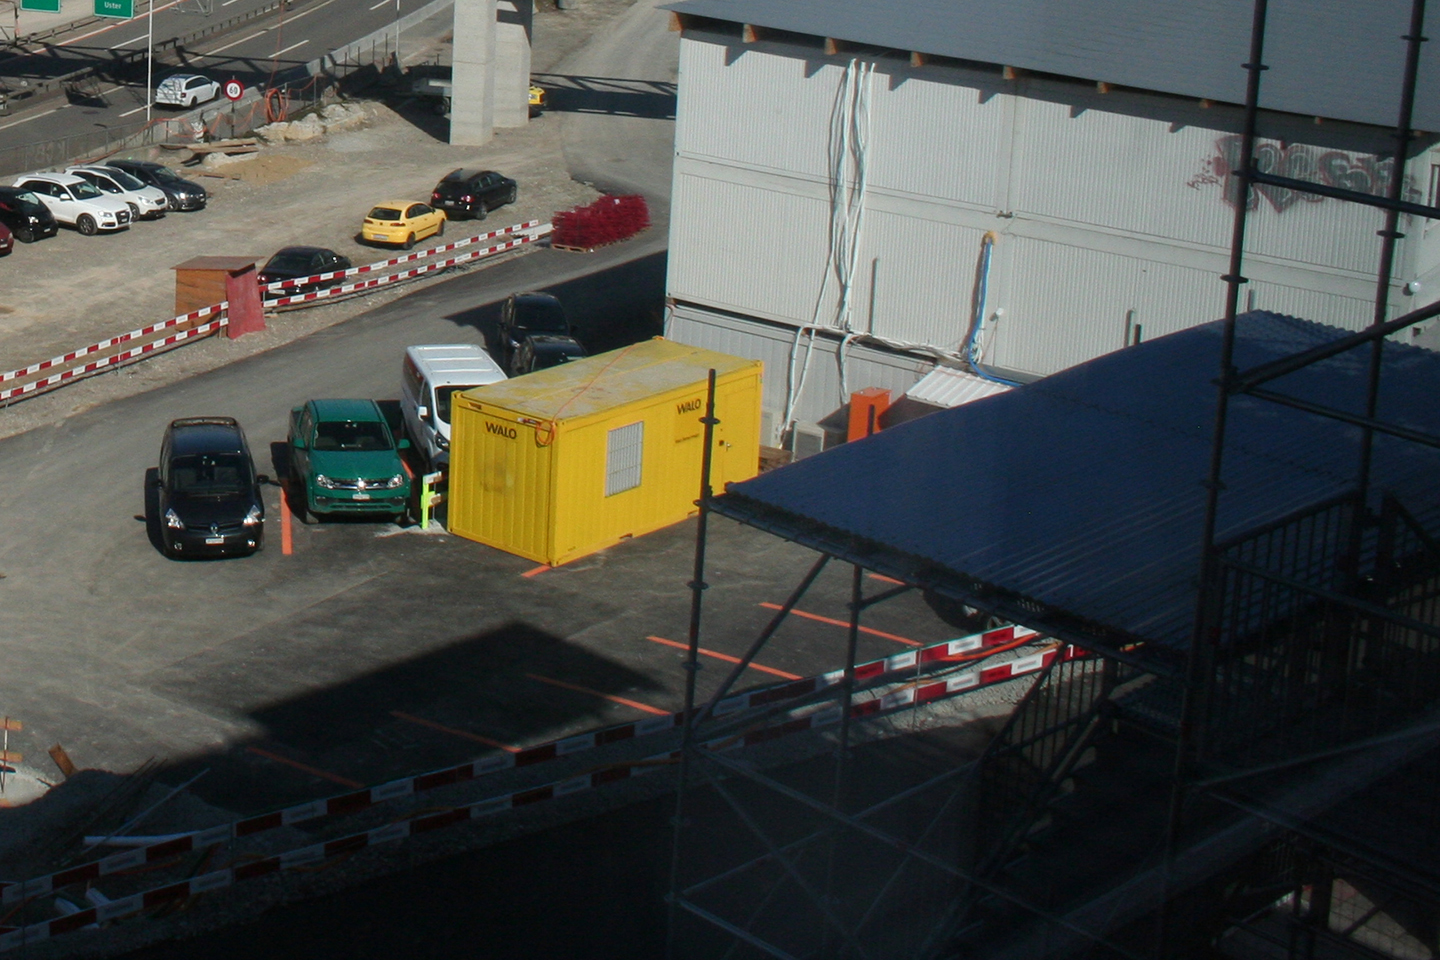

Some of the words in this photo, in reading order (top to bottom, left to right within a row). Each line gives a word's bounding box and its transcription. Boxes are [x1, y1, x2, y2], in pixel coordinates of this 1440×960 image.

[104, 1, 121, 9] Uster
[229, 86, 238, 95] 60
[676, 398, 702, 415] WALO
[485, 421, 517, 440] WALO
